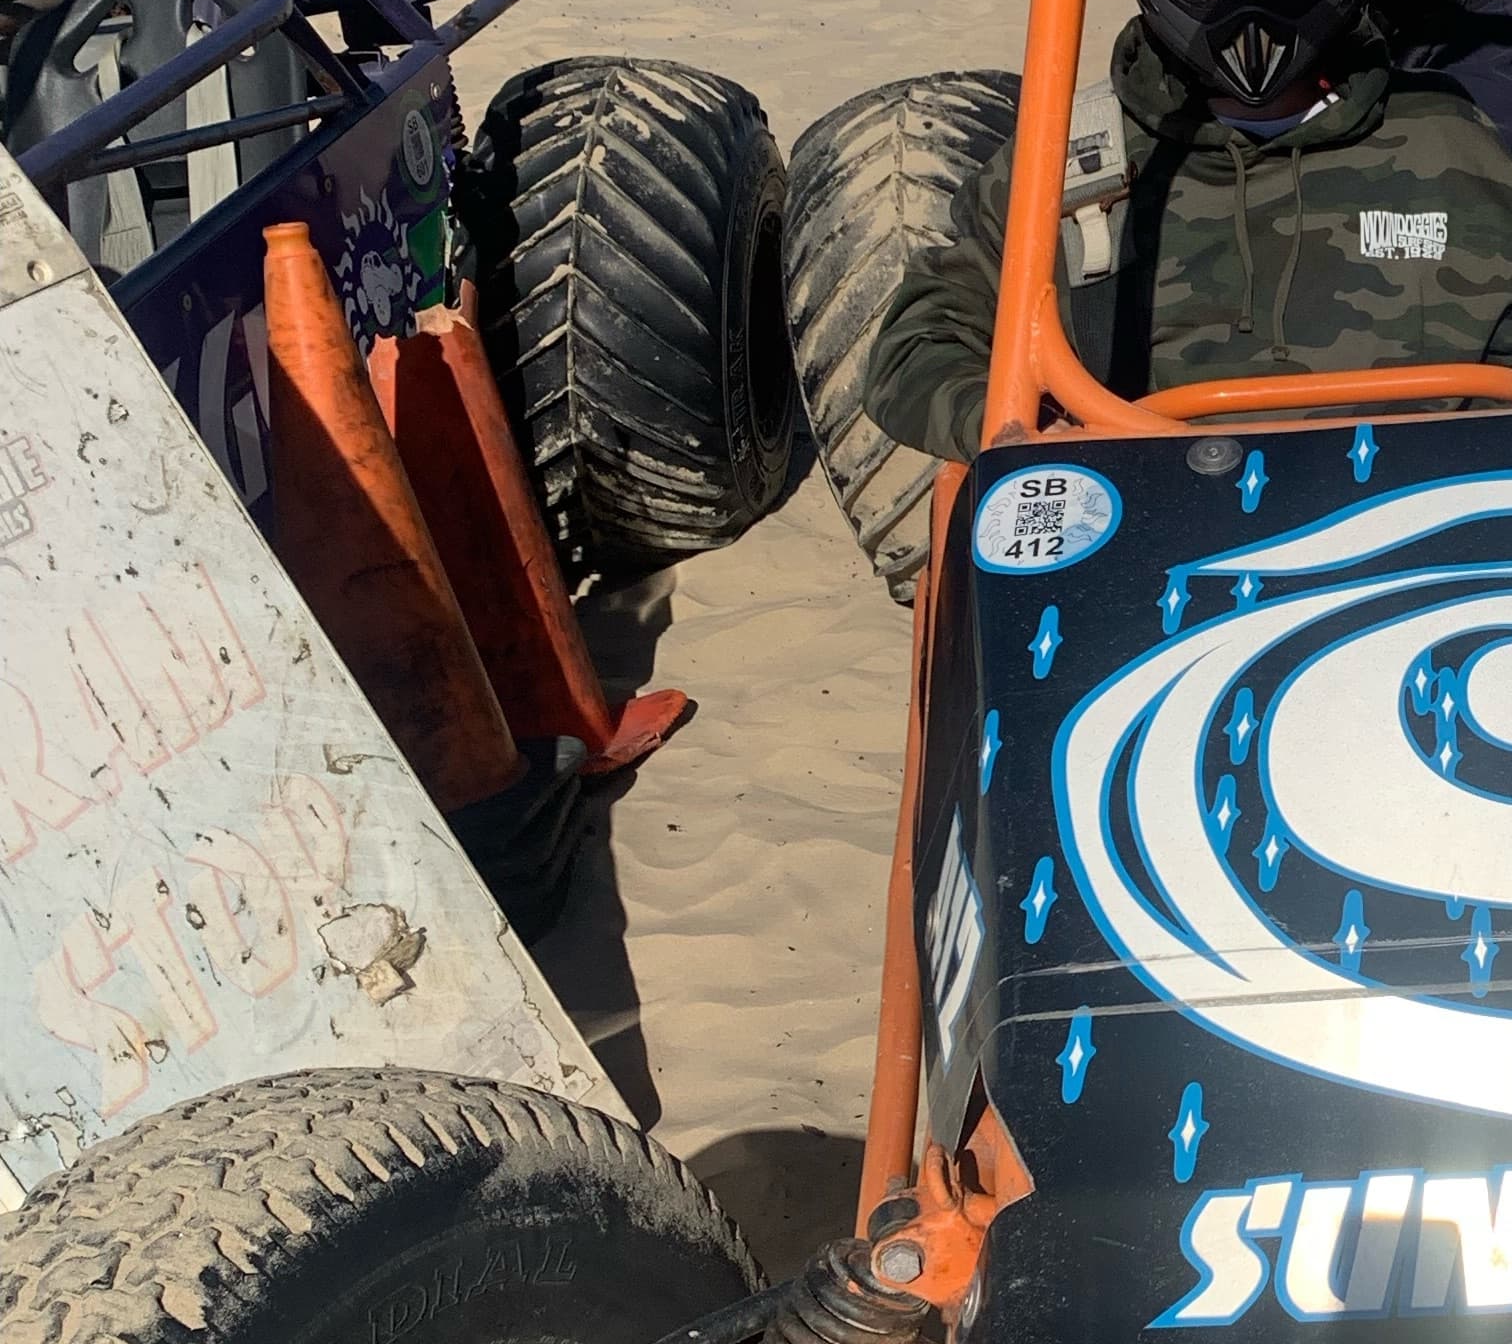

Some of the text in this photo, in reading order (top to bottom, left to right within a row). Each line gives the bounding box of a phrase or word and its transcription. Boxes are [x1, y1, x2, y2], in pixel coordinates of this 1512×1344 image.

[1360, 210, 1447, 254] MOONDOGGIES
[1020, 478, 1068, 498] SB
[1004, 536, 1065, 559] 412
